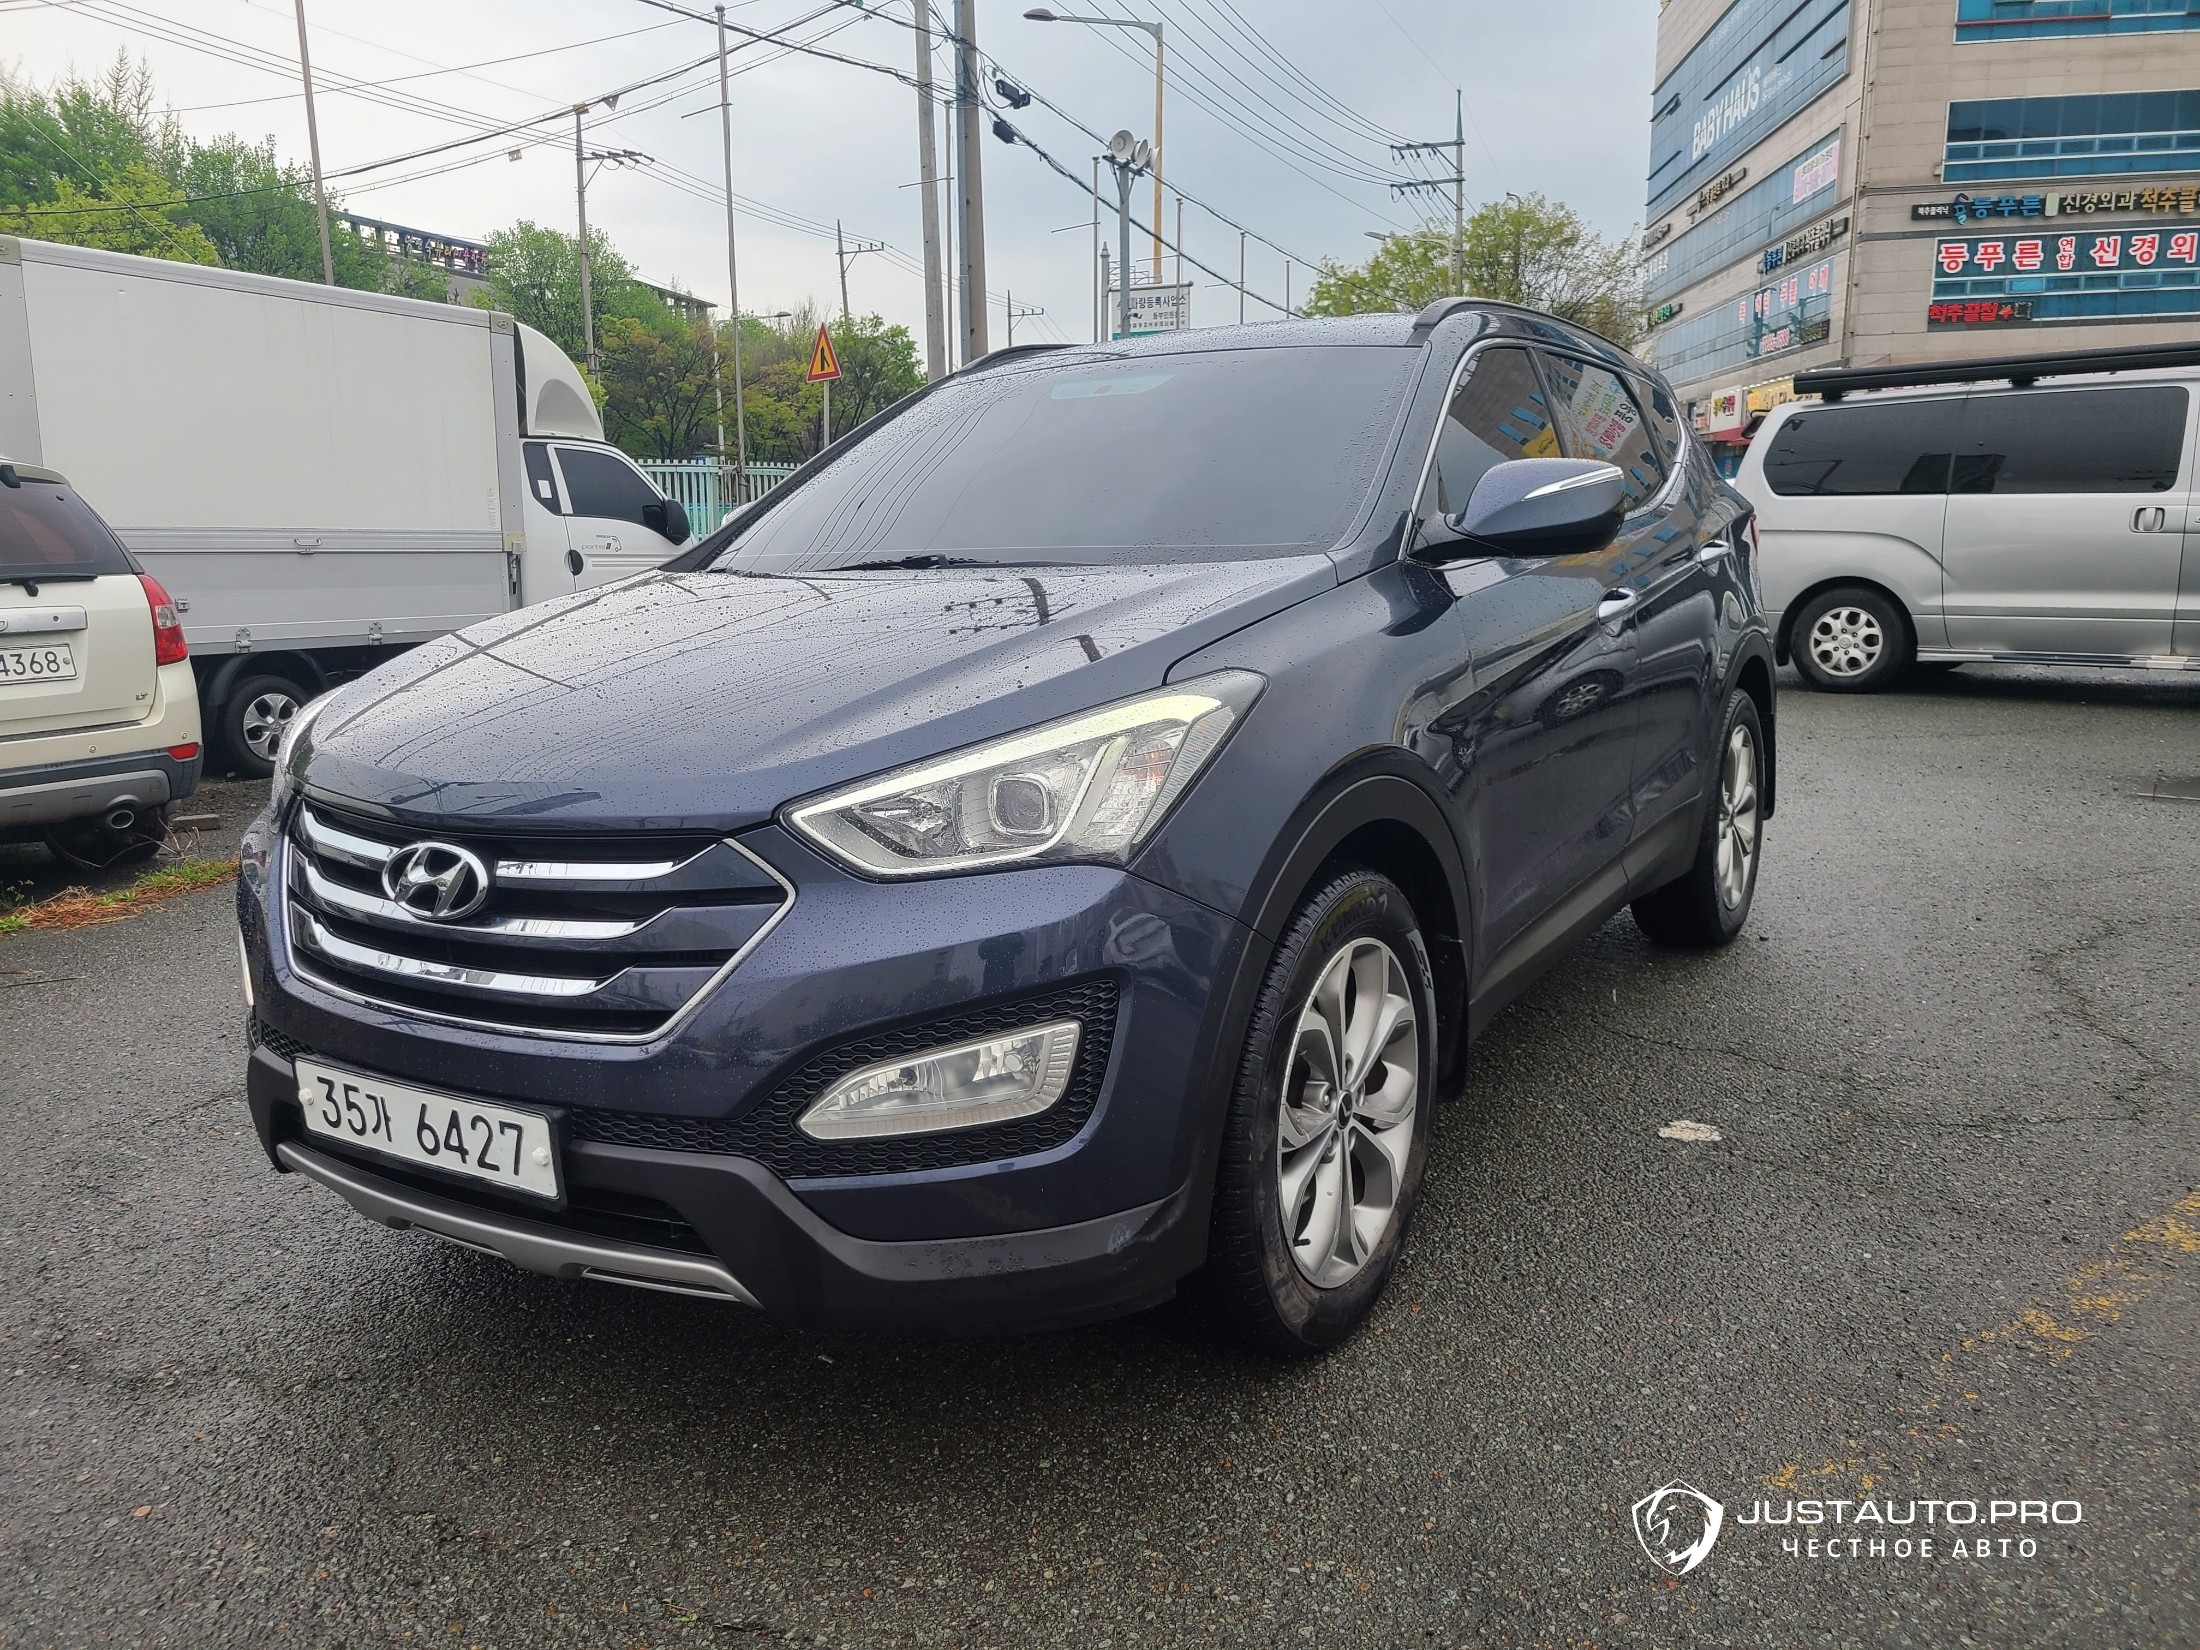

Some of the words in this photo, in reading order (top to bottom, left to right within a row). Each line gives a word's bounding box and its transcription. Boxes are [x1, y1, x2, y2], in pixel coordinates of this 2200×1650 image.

[1692, 98, 1724, 160] BABY
[1971, 194, 2042, 219] 등푸른
[2062, 191, 2137, 214] 신경외과
[2140, 186, 2200, 214] 척추클
[1938, 240, 2043, 274] 등푸른
[2057, 236, 2075, 270] 연합
[1128, 294, 1187, 309] 량등록사업소
[0, 651, 61, 677] 4368
[316, 1075, 393, 1143] 35가
[416, 1101, 524, 1176] 6427
